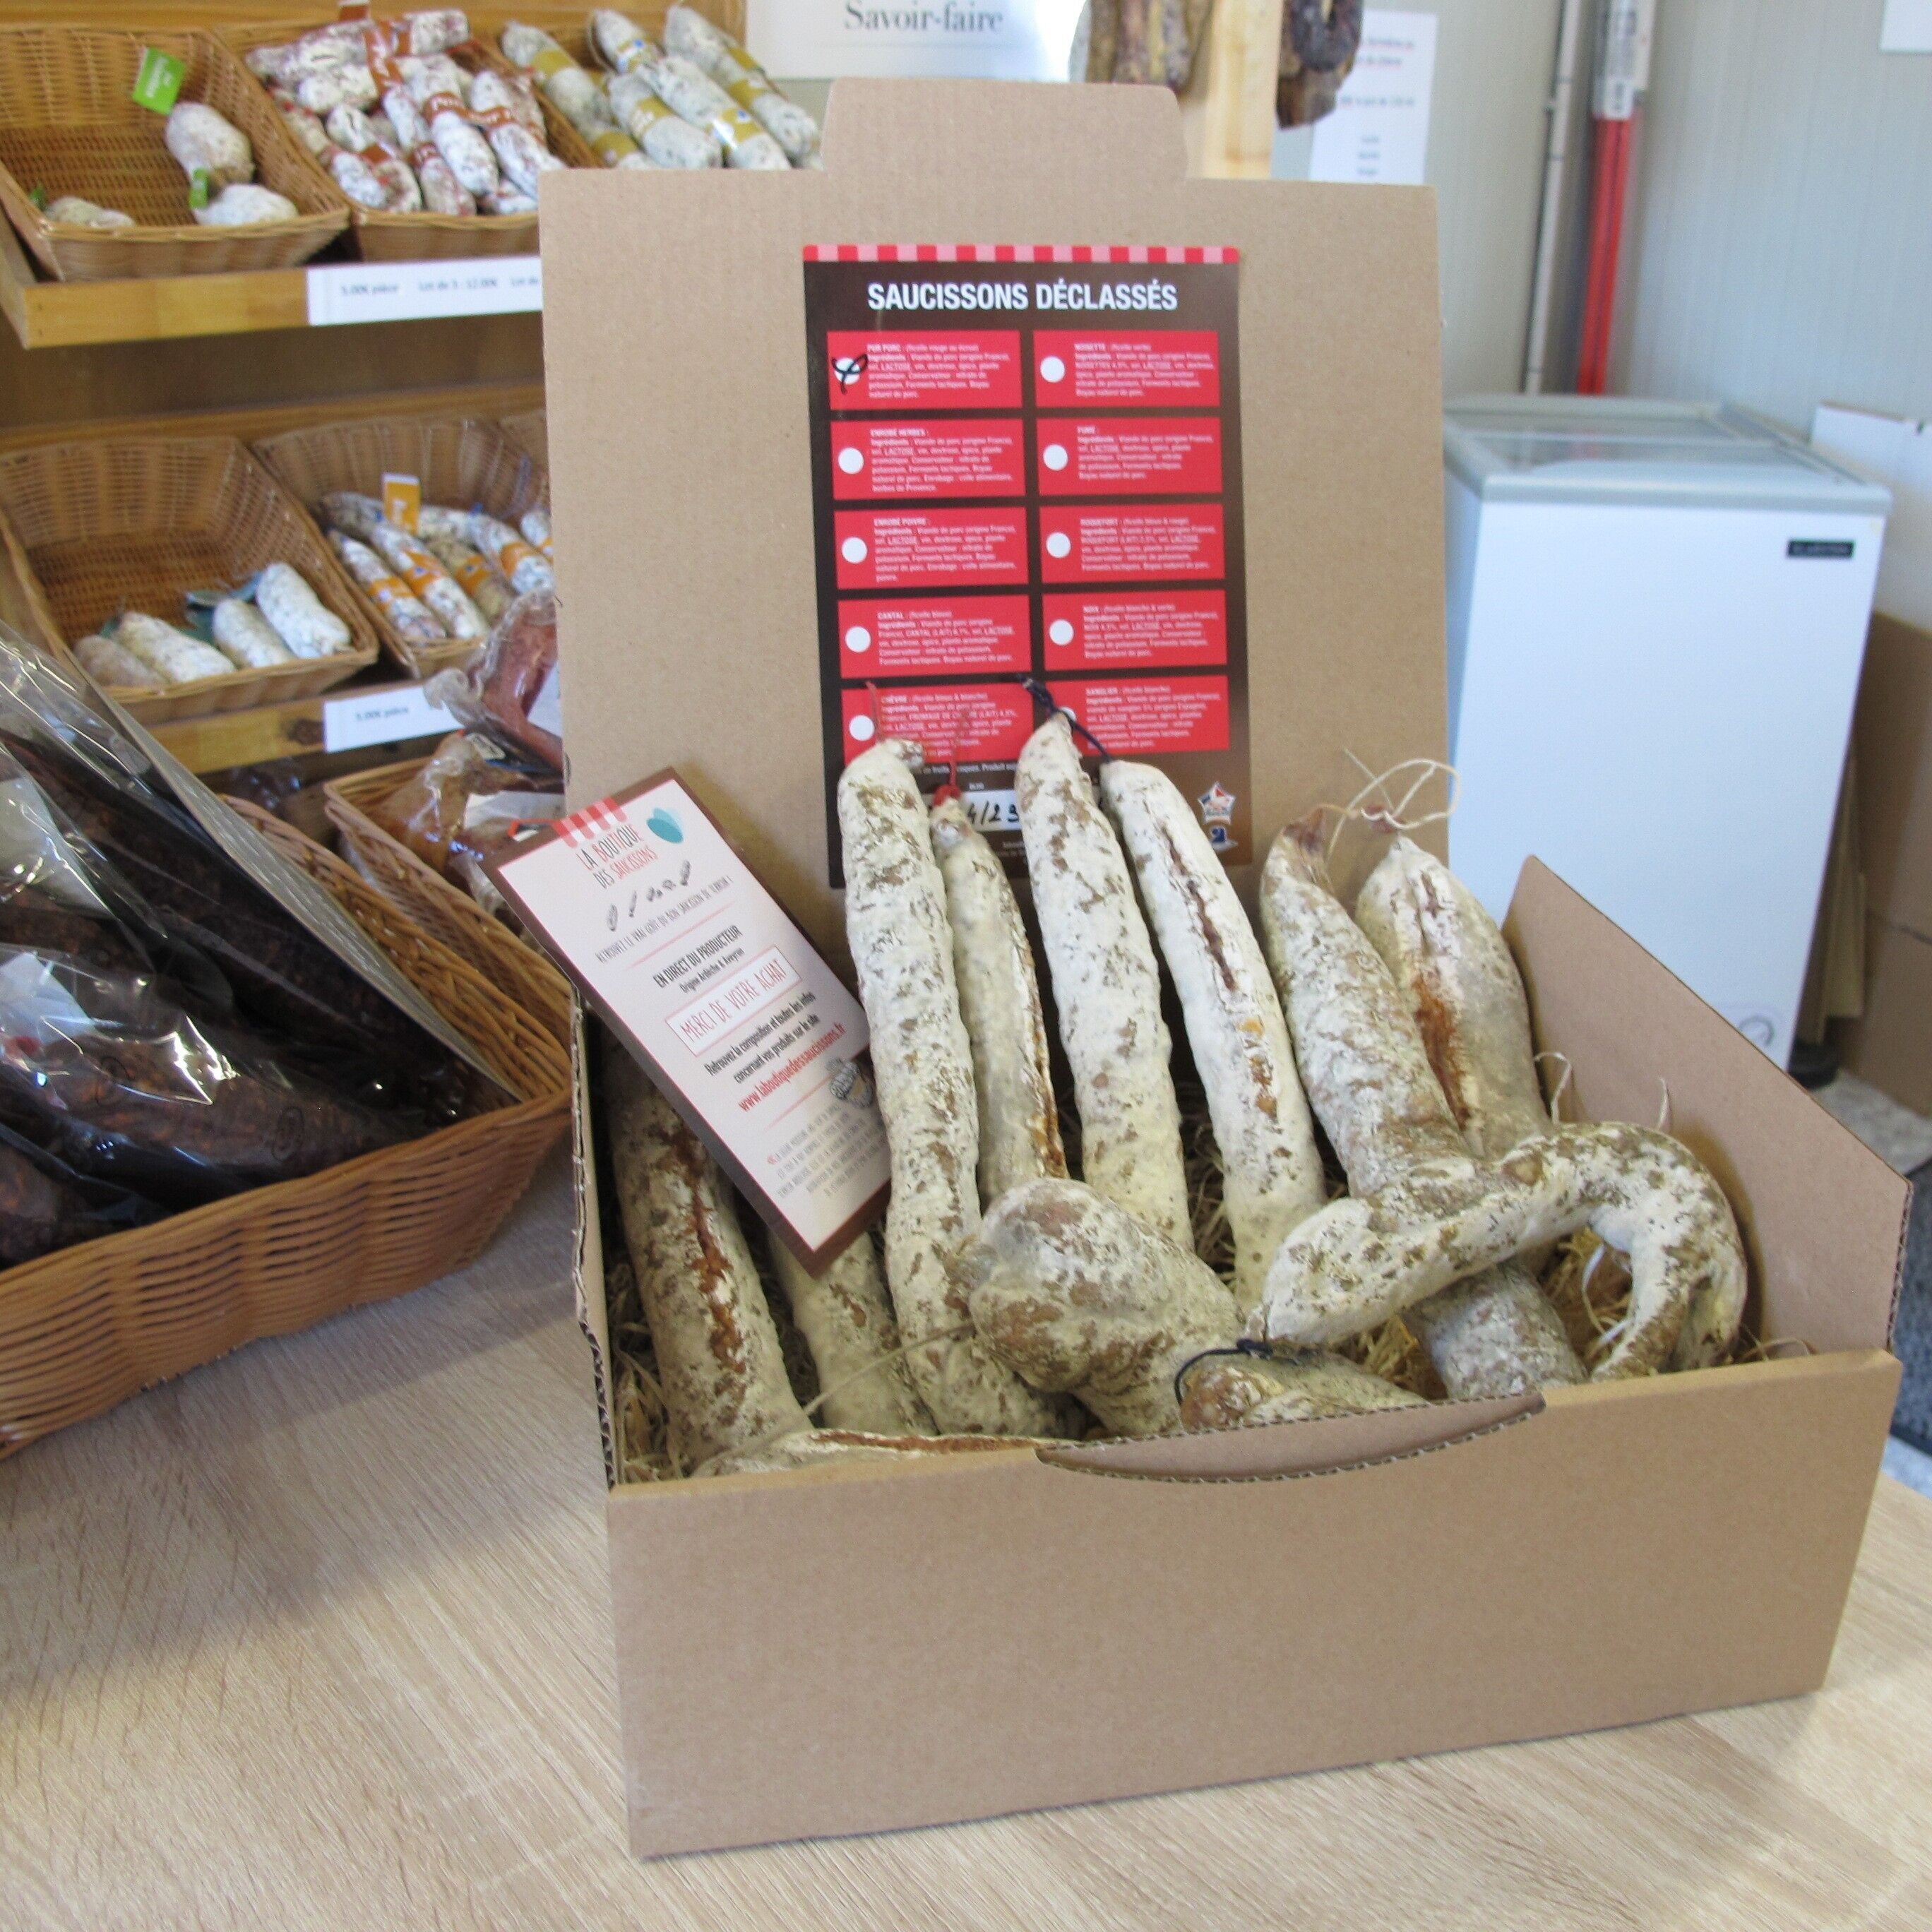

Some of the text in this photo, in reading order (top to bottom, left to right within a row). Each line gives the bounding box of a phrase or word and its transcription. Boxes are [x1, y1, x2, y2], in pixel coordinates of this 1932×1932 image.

[845, 0, 1003, 30] Savoir-faire
[868, 278, 1178, 310] SAUCISSONS DÉCLASSÉS
[573, 822, 645, 871] LA BOUTIQUE
[592, 844, 659, 889] DES SAUCISSONS
[652, 923, 743, 989] EN DIRECT DU PRODUCTEUR
[679, 958, 789, 1042] MERCI DE VOTRE ACHAT
[703, 1046, 737, 1077] Retrouvez
[737, 1020, 776, 1055] composition
[731, 1054, 765, 1084] concernant
[768, 1030, 798, 1057] produits
